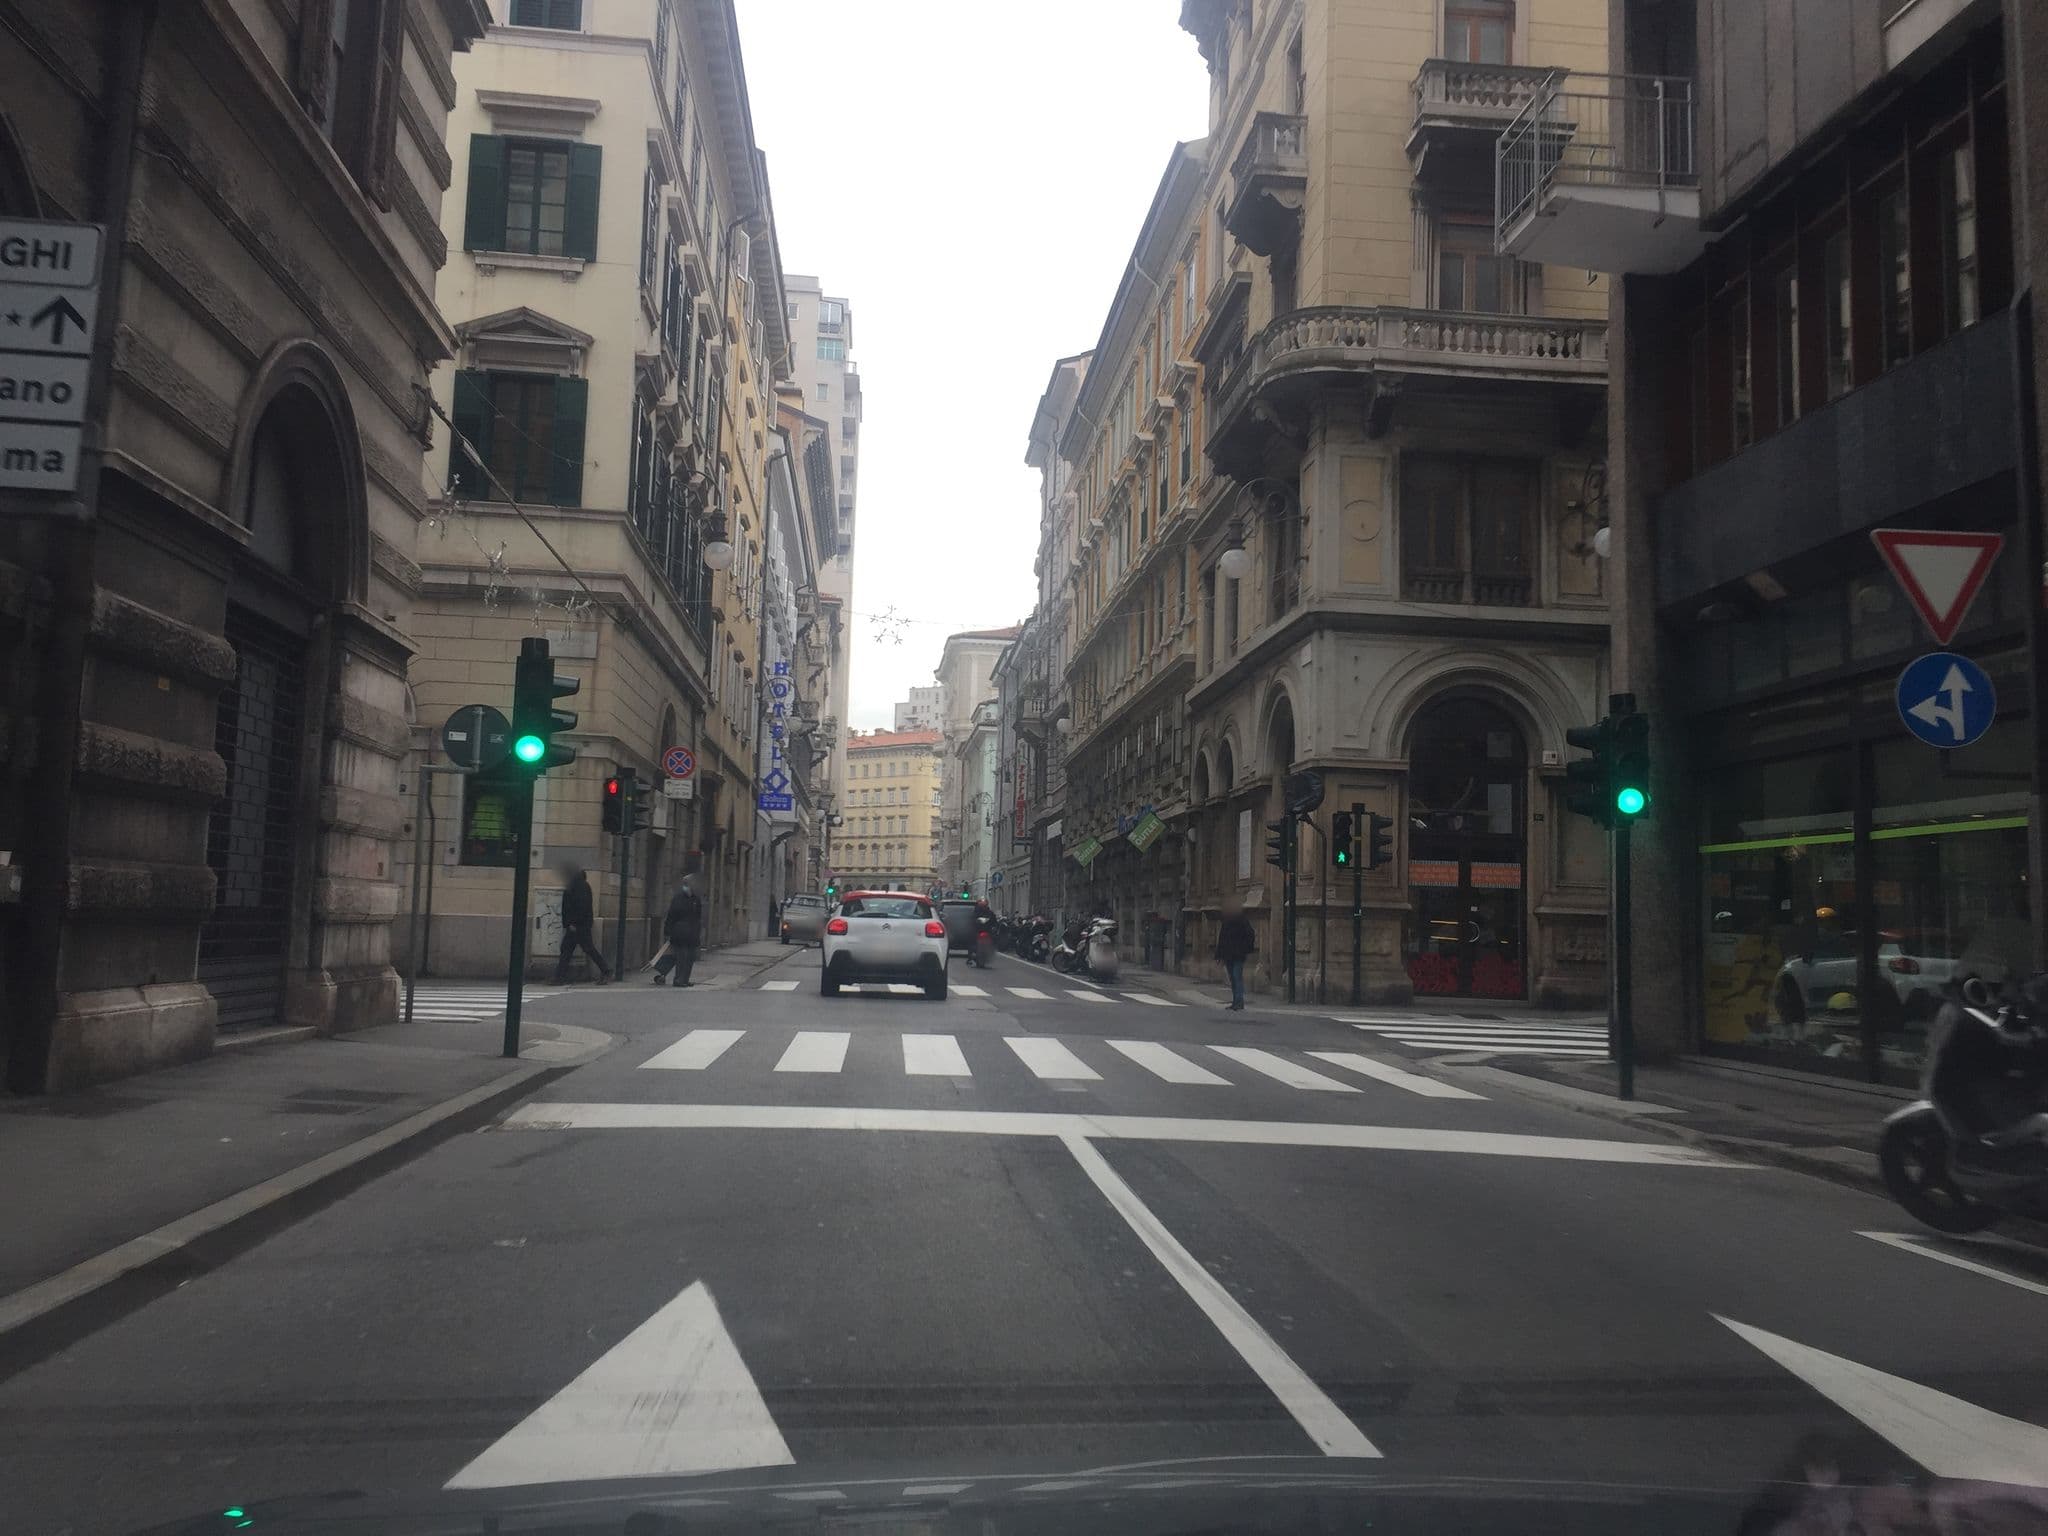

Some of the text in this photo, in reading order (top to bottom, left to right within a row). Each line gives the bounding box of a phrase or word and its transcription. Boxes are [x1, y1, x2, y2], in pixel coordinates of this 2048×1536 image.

[0, 236, 73, 271] GHI
[0, 376, 73, 405] ano
[4, 446, 64, 474] ma
[772, 662, 789, 760] HOTEL
[1135, 818, 1160, 846] OUTLET
